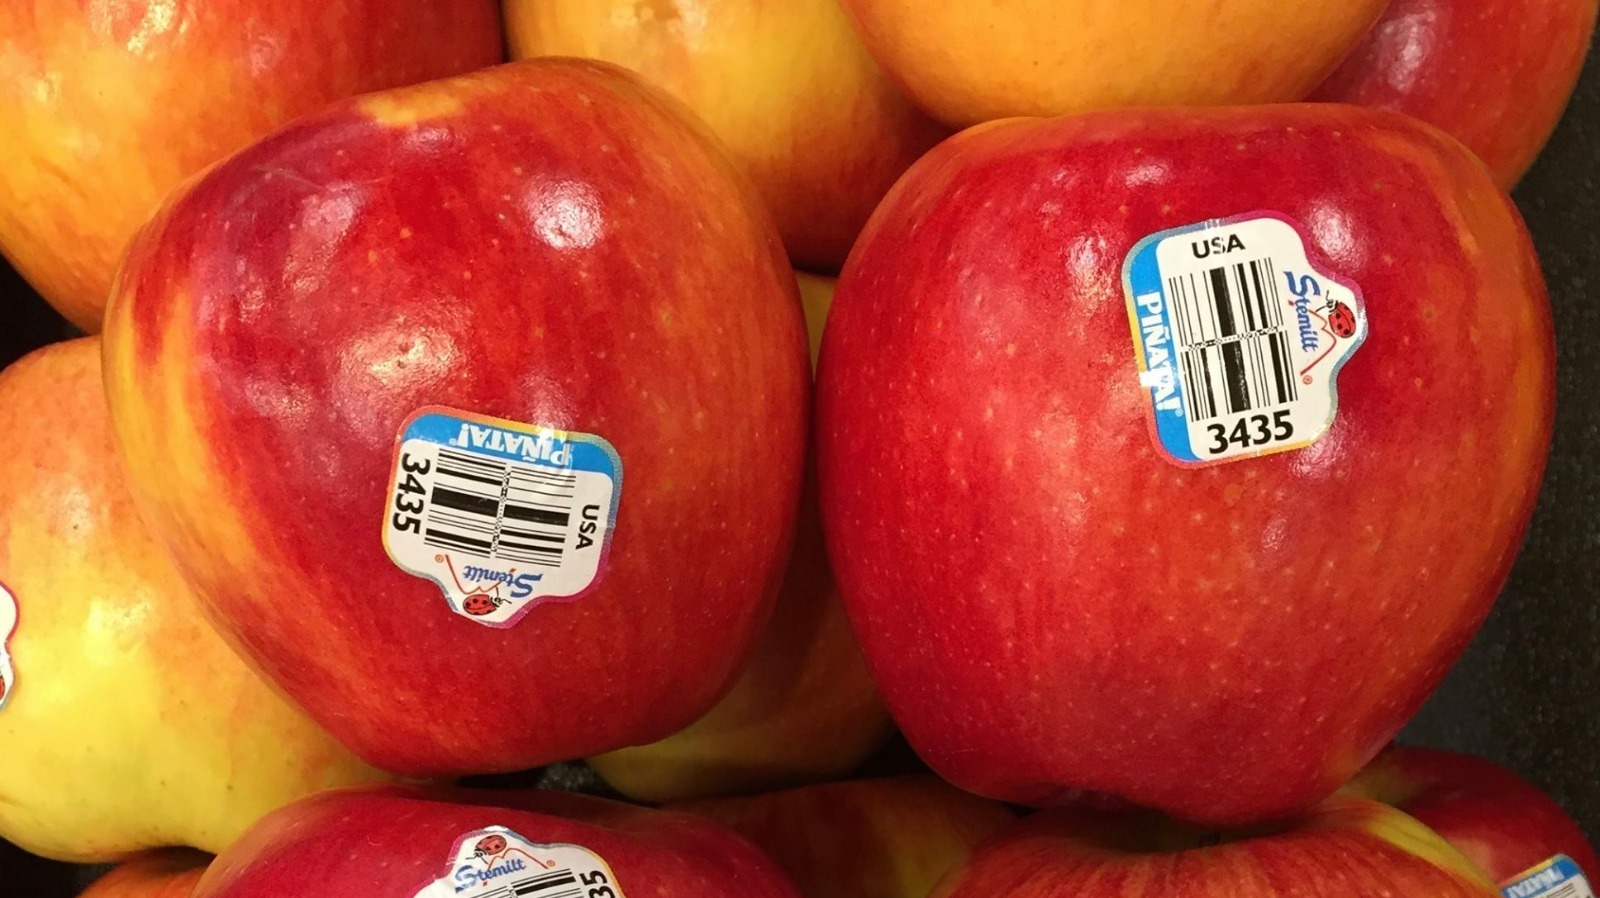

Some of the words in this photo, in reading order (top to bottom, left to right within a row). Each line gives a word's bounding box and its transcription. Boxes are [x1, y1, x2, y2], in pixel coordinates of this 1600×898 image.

[1191, 234, 1246, 259] USA
[1283, 270, 1321, 353] Stemilt
[1137, 292, 1182, 411] PIÑATA!
[457, 423, 574, 467] PIÑATA!
[1206, 409, 1295, 455] 3435
[392, 452, 431, 535] 3435
[575, 504, 600, 551] USA
[462, 564, 543, 599] Stemilt
[454, 858, 527, 894] Stemilt
